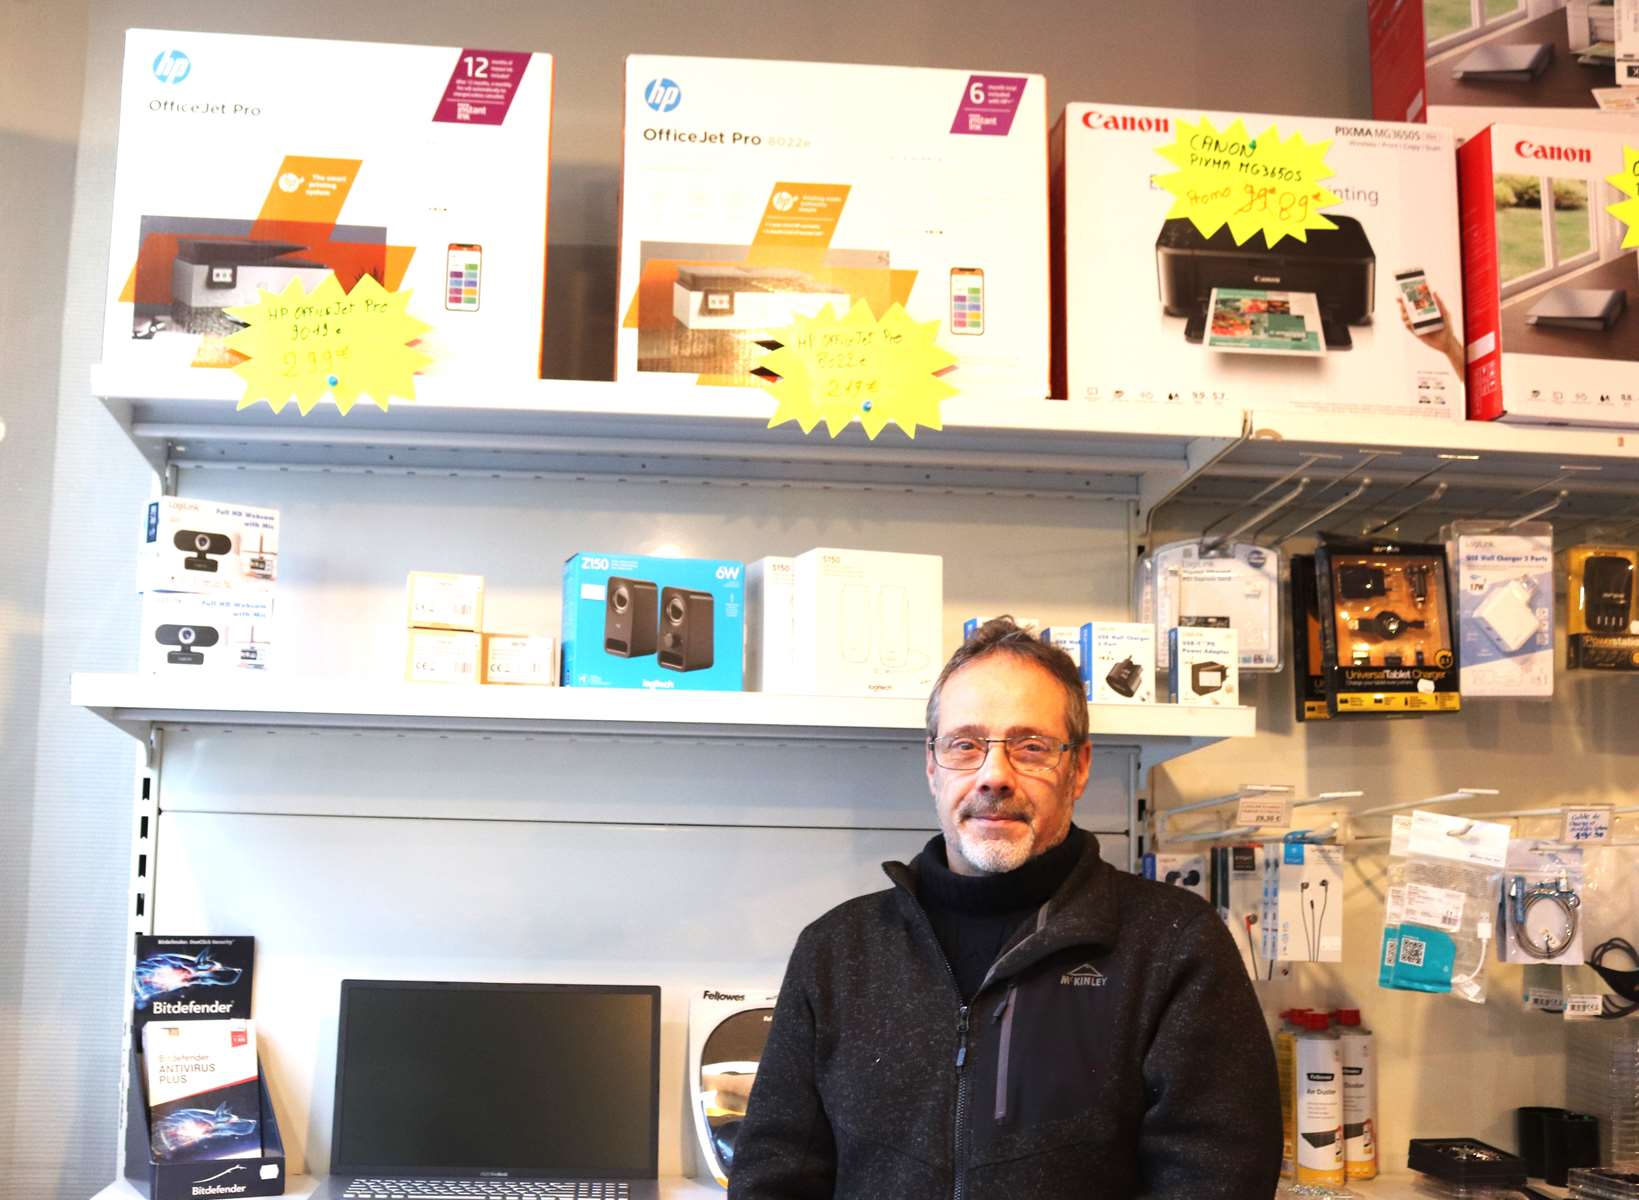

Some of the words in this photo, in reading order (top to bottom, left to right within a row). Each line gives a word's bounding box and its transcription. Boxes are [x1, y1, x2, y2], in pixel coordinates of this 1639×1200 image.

[154, 50, 190, 84] hp
[463, 56, 489, 78] 12
[645, 78, 681, 113] hp
[969, 82, 985, 104] 6
[234, 104, 262, 116] Pro
[1082, 111, 1170, 133] Canon
[643, 128, 725, 145] OfficeJet
[732, 132, 762, 146] Pro
[1335, 126, 1374, 137] PIXMA
[1190, 134, 1255, 158] CANON
[1514, 140, 1592, 163] Canon
[1238, 162, 1303, 182] MG3650S
[580, 557, 609, 570] Z150
[715, 566, 740, 580] 6W
[703, 990, 745, 1002] Fellowes
[152, 1000, 233, 1015] Bitdefender
[159, 1064, 216, 1074] ANTIVIRUS
[159, 1074, 188, 1085] PLUS
[192, 1184, 247, 1197] Bitdefender
